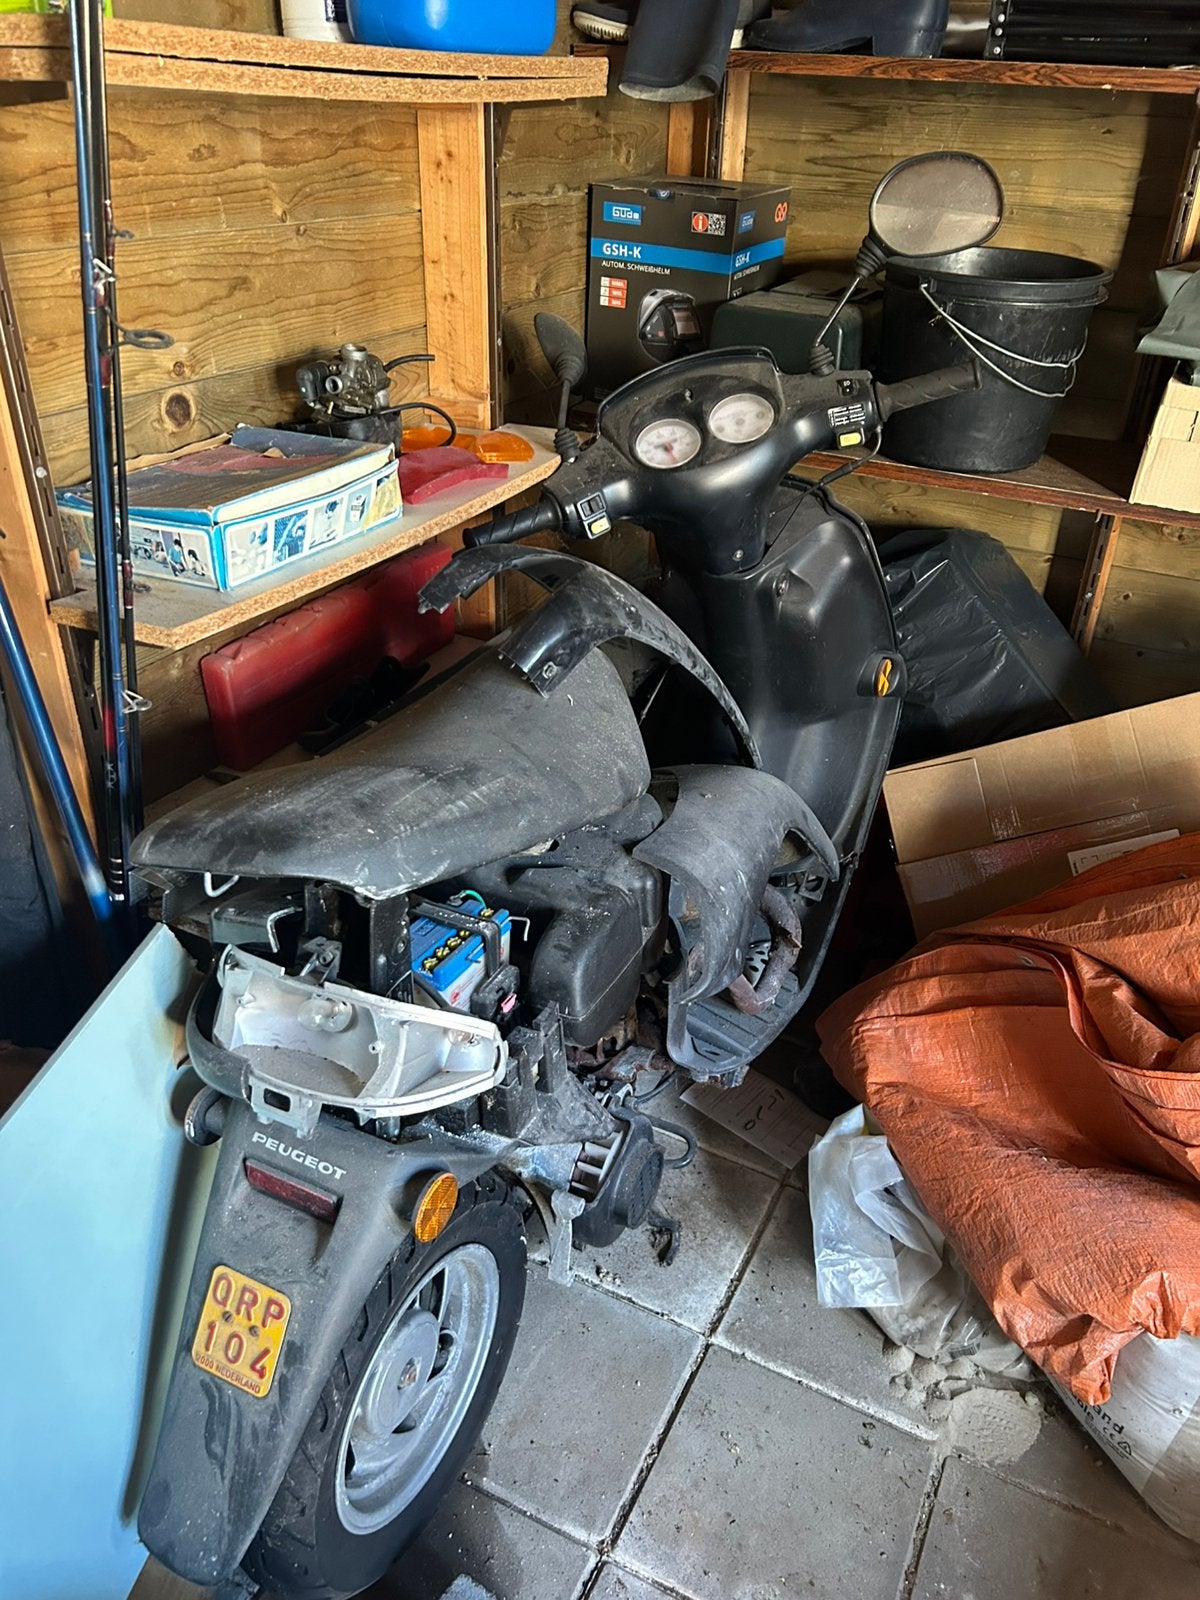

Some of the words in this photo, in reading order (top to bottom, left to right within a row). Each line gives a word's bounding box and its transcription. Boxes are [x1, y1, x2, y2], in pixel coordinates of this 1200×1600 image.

[601, 260, 626, 269] AUTOM.
[602, 242, 642, 259] GSH-K
[251, 1131, 347, 1180] PEUGEOT
[212, 1272, 286, 1329] QRP
[205, 1319, 272, 1380] 104
[216, 1363, 261, 1394] NEDERLAND
